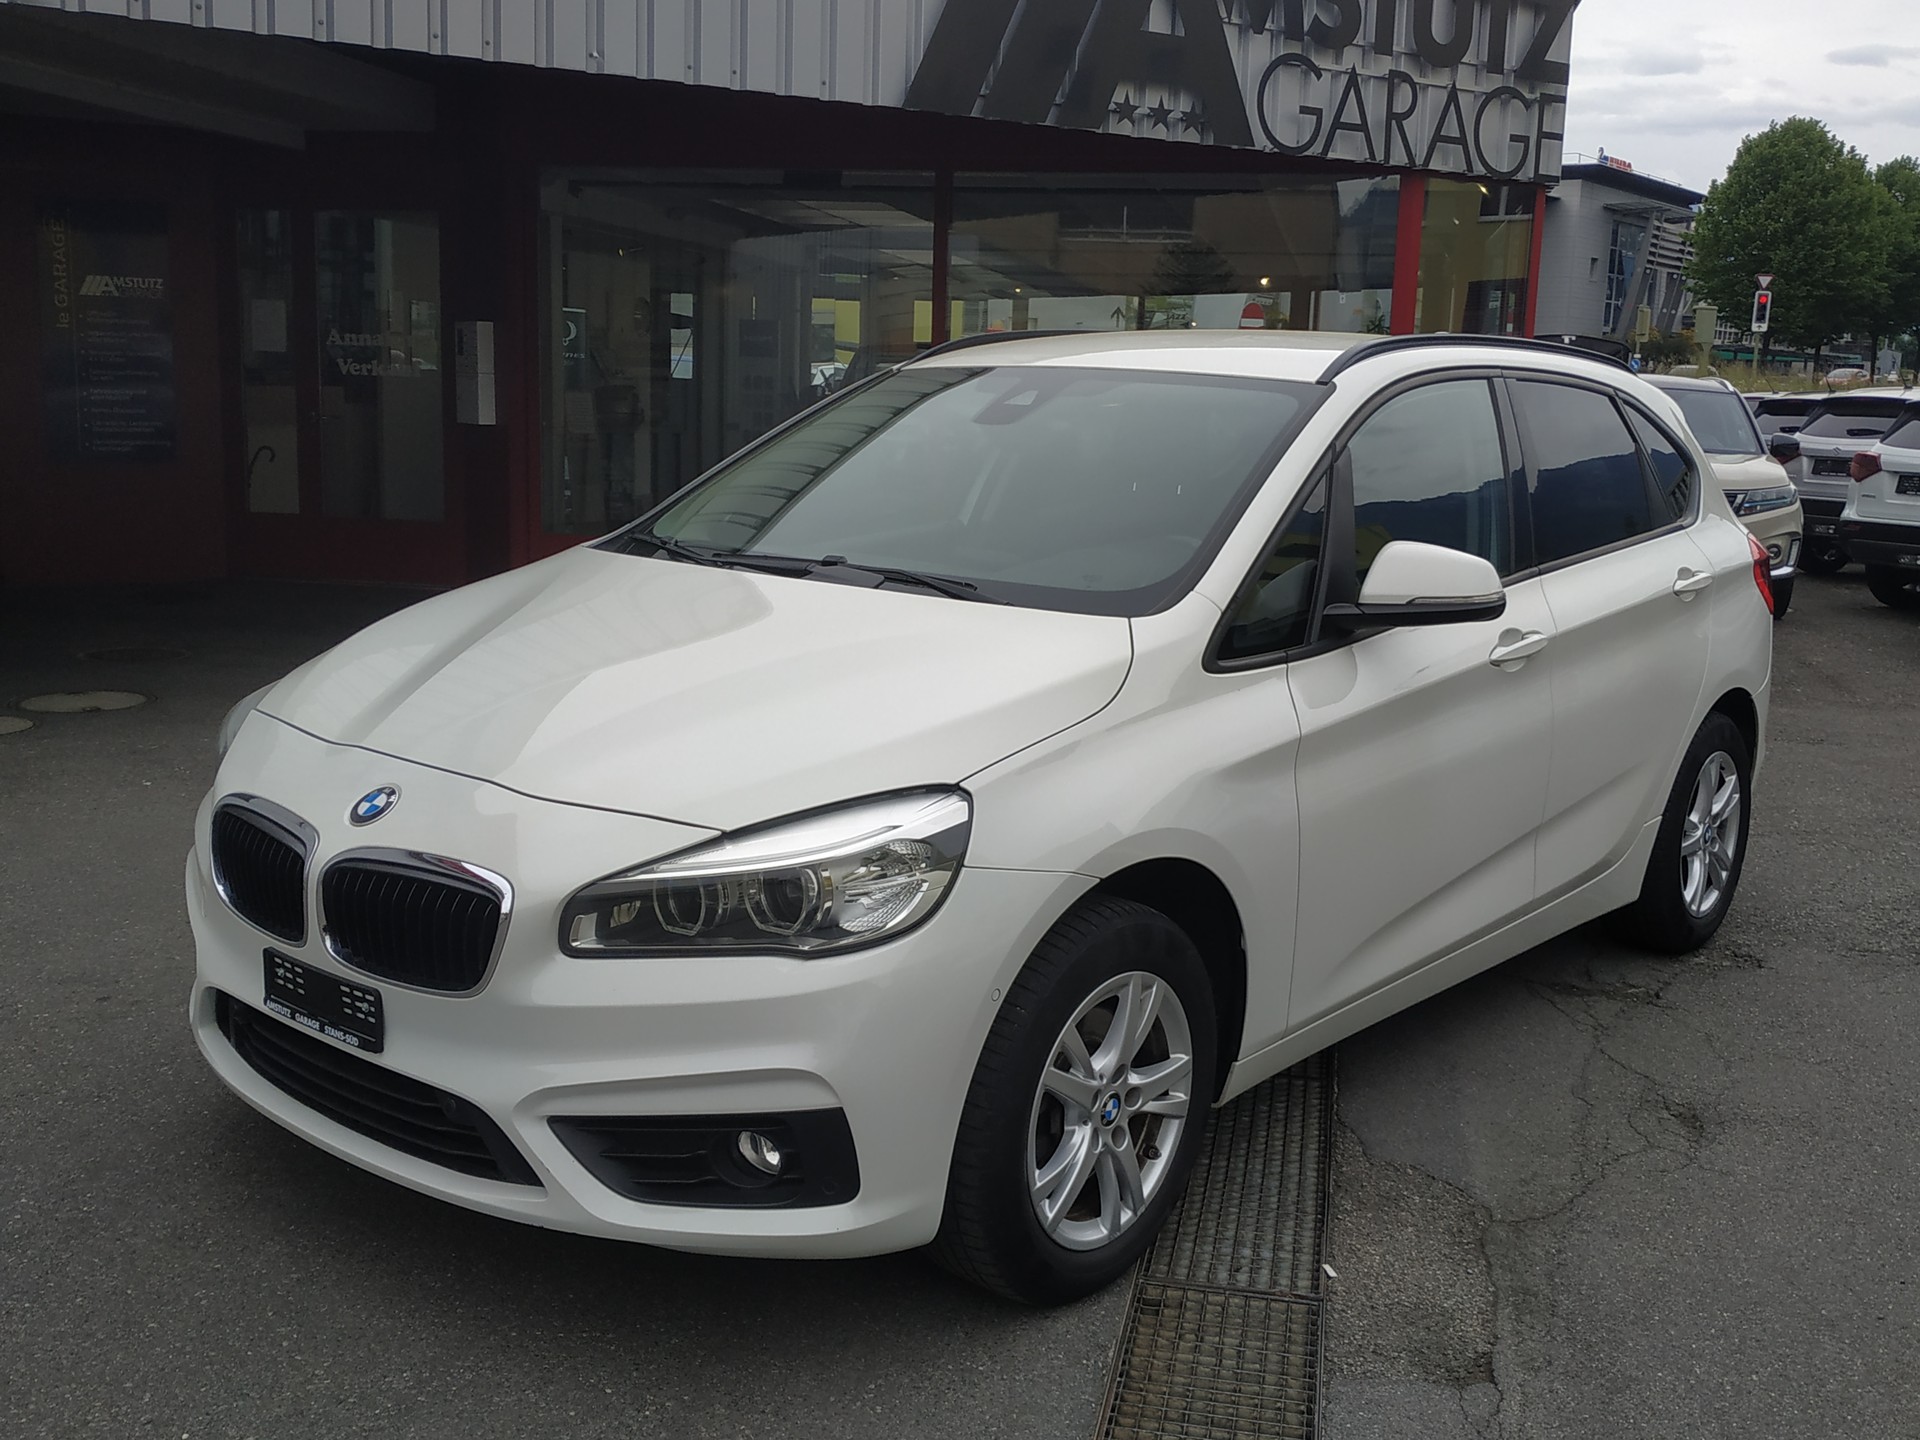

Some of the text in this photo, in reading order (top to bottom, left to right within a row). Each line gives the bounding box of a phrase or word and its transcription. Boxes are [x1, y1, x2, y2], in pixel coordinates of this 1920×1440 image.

[1256, 52, 1567, 186] GARAGE
[51, 217, 68, 308] GARAGE
[96, 275, 165, 297] AMSTUTZ
[266, 999, 292, 1018] AMSTUTZ
[294, 1012, 321, 1031] GARAGE
